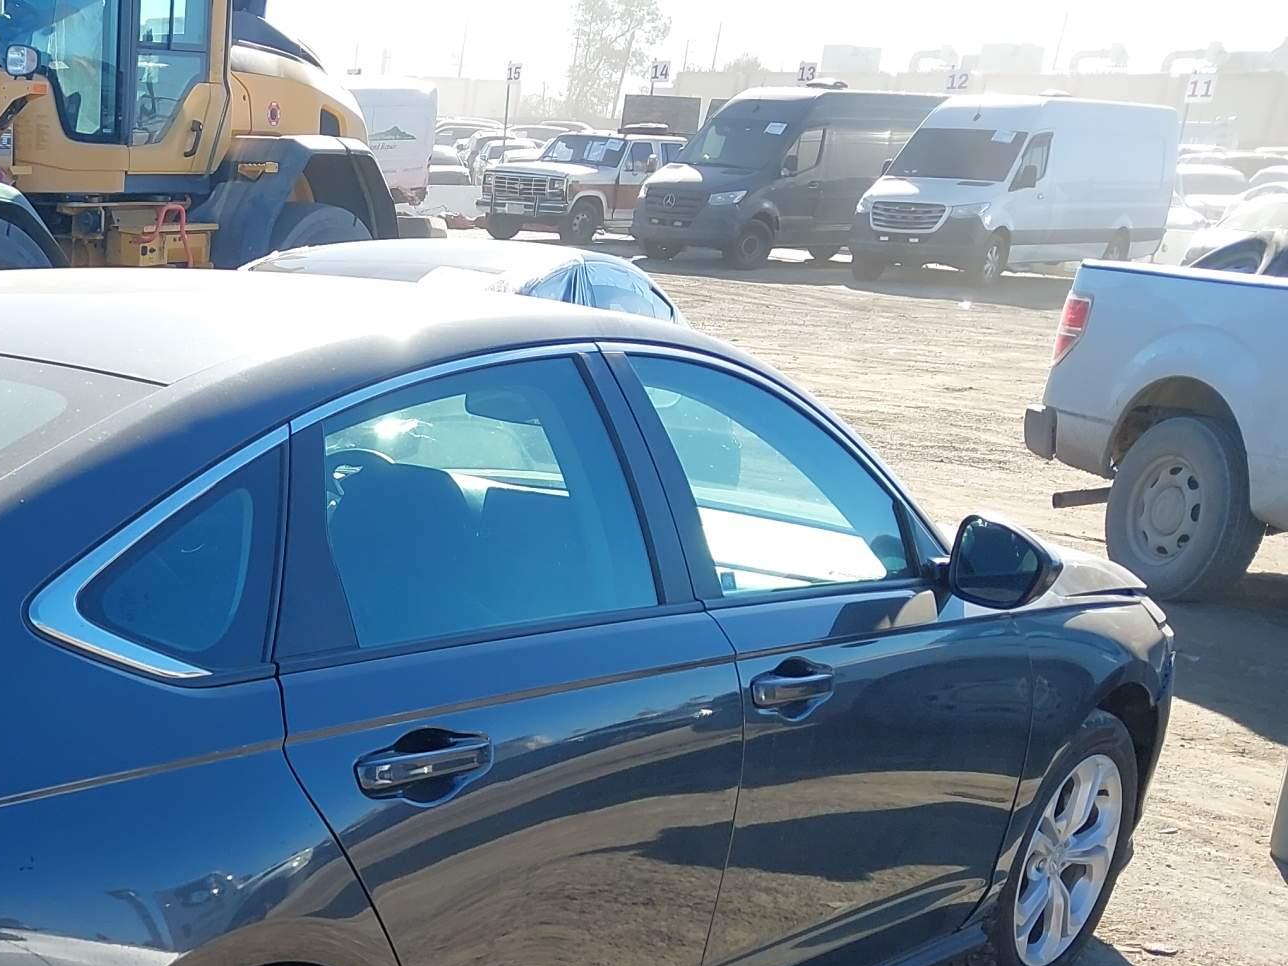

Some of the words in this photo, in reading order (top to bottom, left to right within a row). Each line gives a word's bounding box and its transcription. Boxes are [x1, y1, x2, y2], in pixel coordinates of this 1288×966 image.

[507, 66, 521, 80] 15
[651, 64, 669, 79] 14
[797, 66, 815, 81] 13
[946, 73, 968, 90] 12
[1187, 79, 1212, 97] 11
